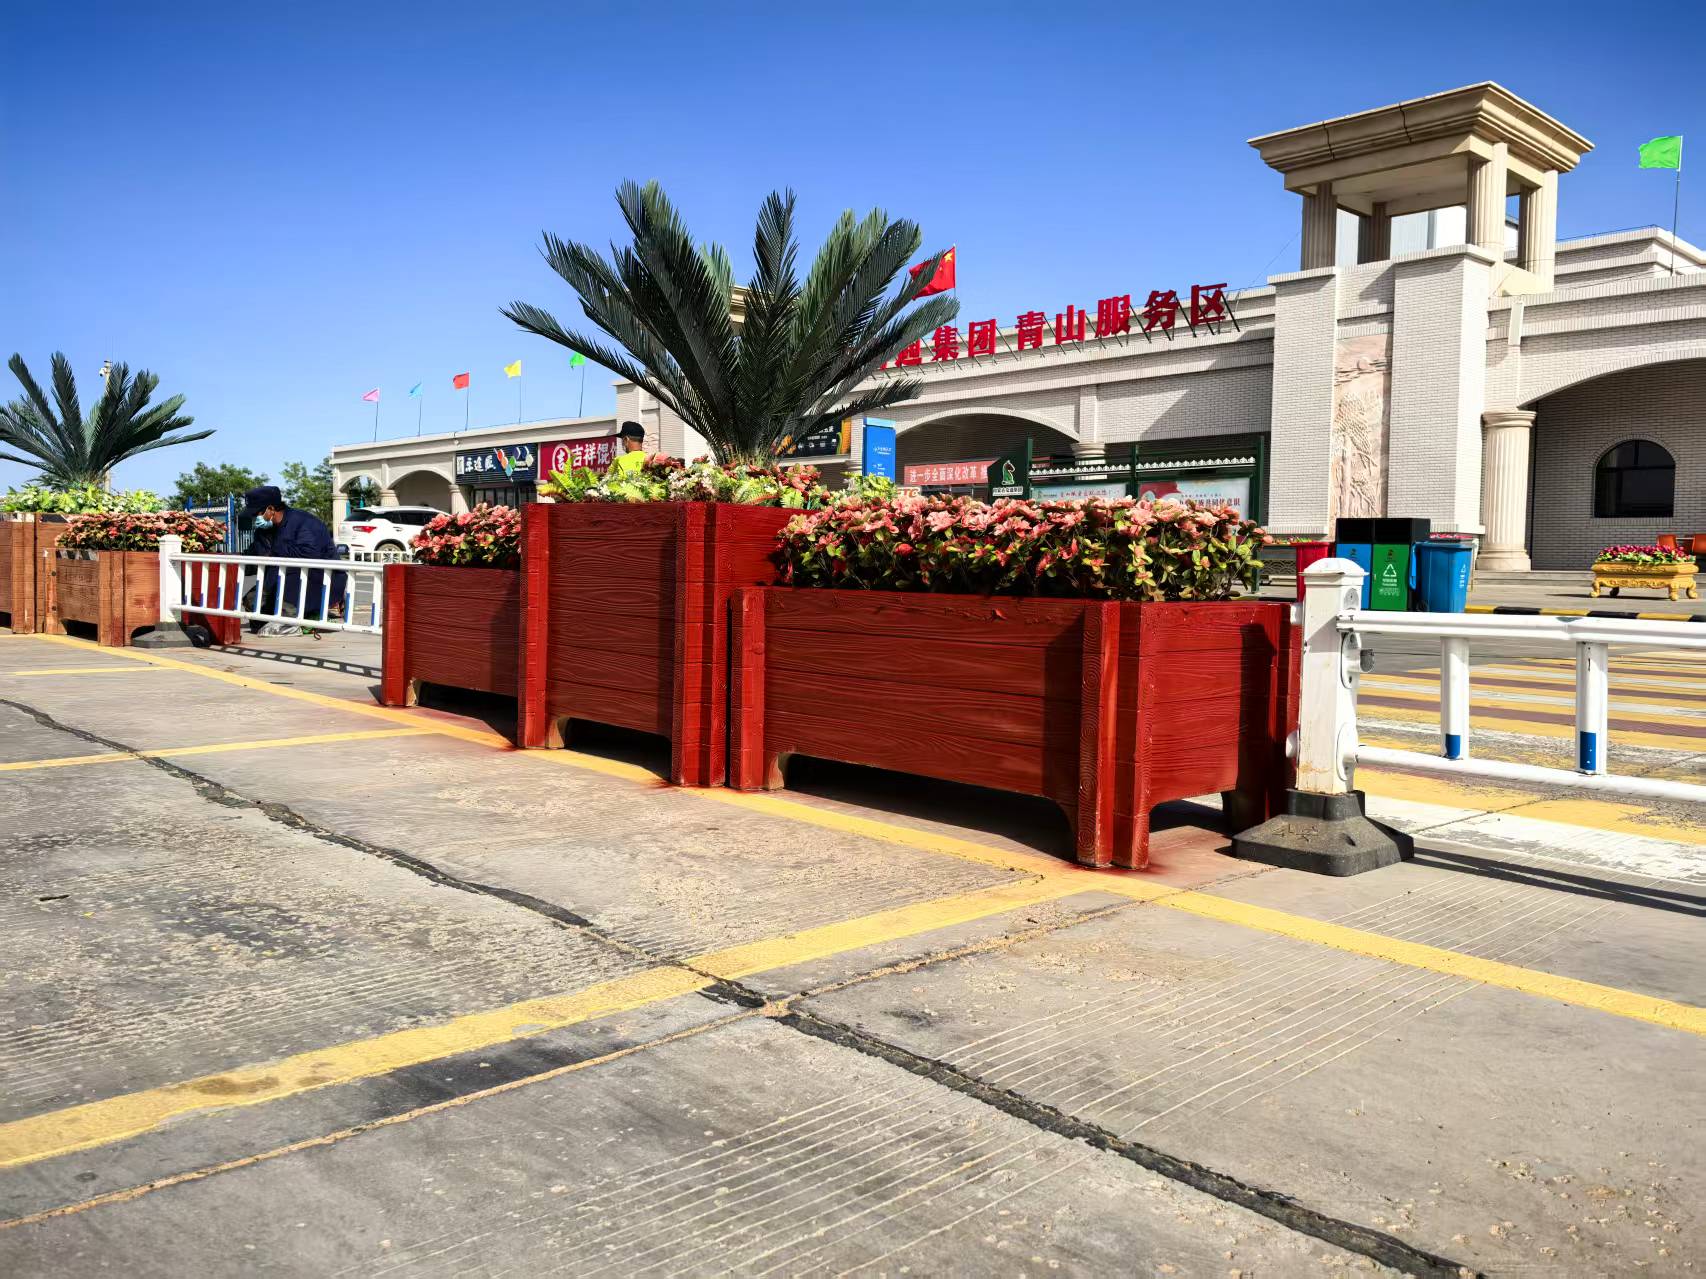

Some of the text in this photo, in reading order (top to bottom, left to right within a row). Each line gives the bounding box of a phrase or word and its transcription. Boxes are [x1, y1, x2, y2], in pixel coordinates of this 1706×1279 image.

[880, 283, 1227, 369] 通集团 青山服务区
